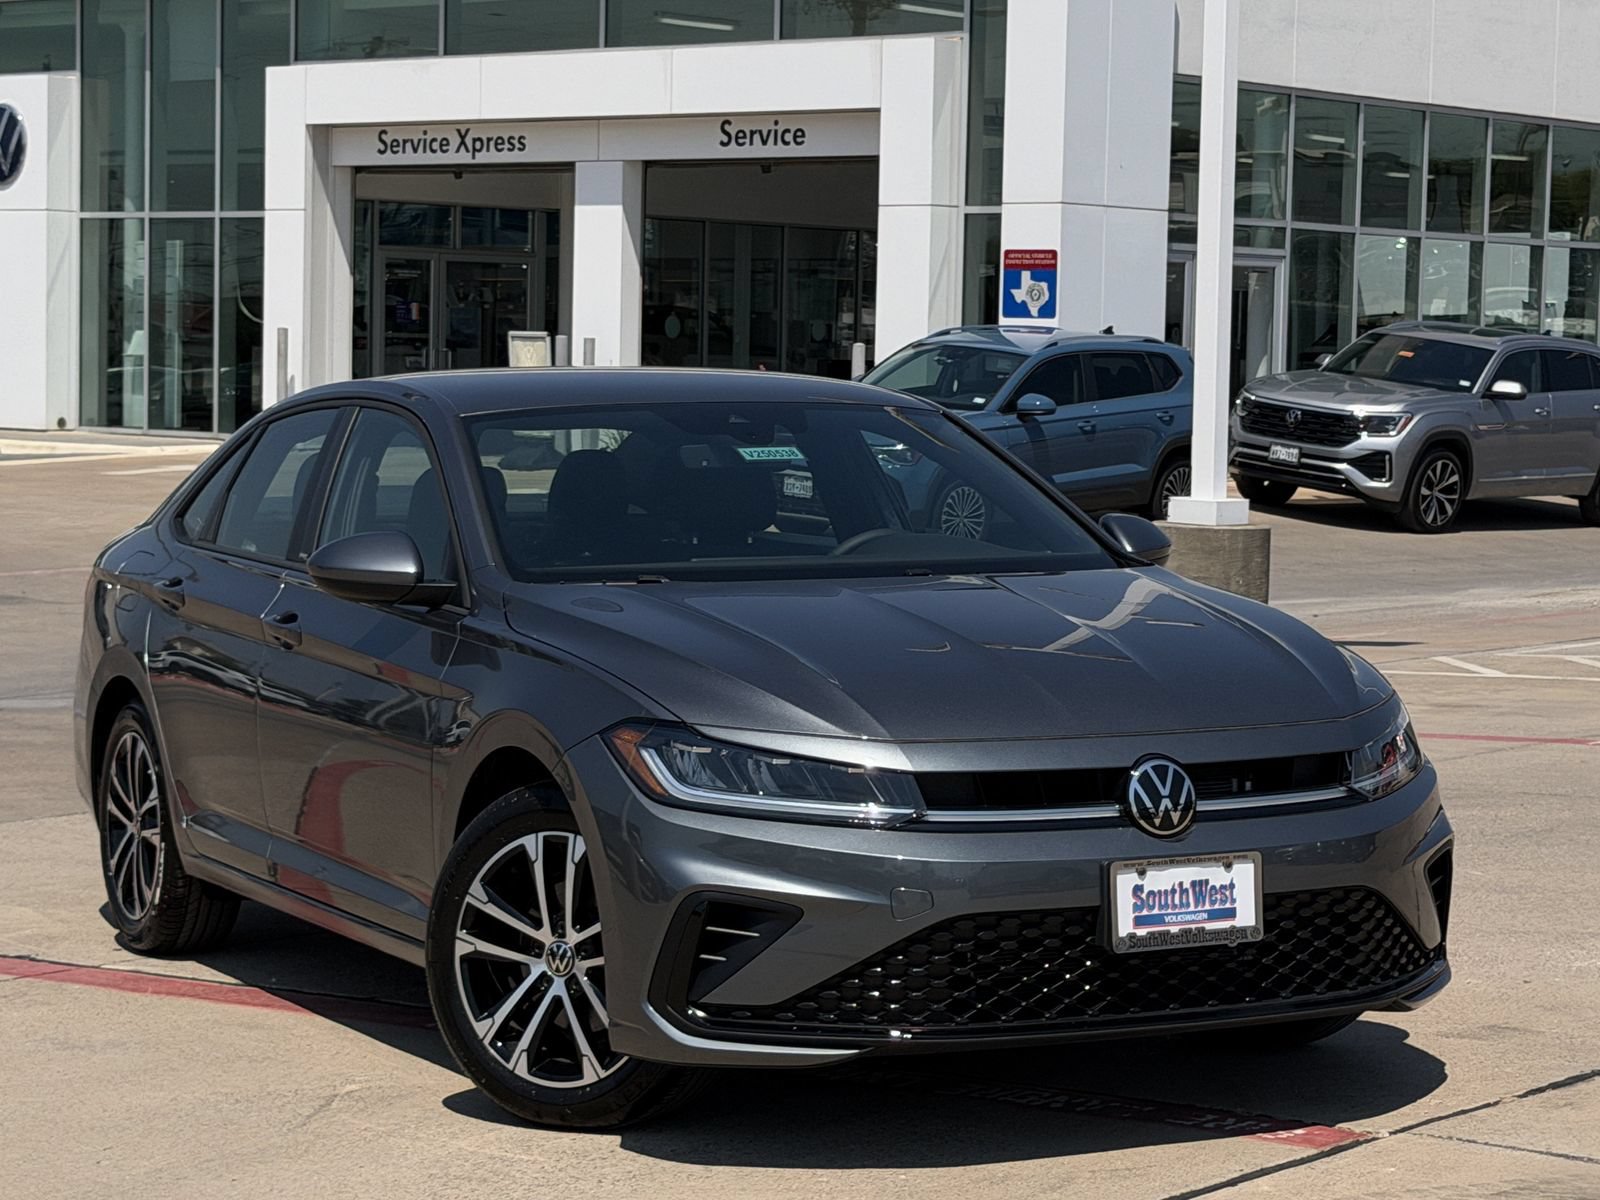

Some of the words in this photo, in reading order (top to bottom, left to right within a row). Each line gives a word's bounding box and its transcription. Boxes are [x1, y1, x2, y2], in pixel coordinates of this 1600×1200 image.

[376, 129, 450, 155] Service
[454, 127, 527, 160] Xpress
[719, 119, 806, 147] Service
[743, 448, 799, 459] V250538
[1131, 877, 1237, 914] SouthWest
[1163, 912, 1209, 924] VOLKSWAGEN
